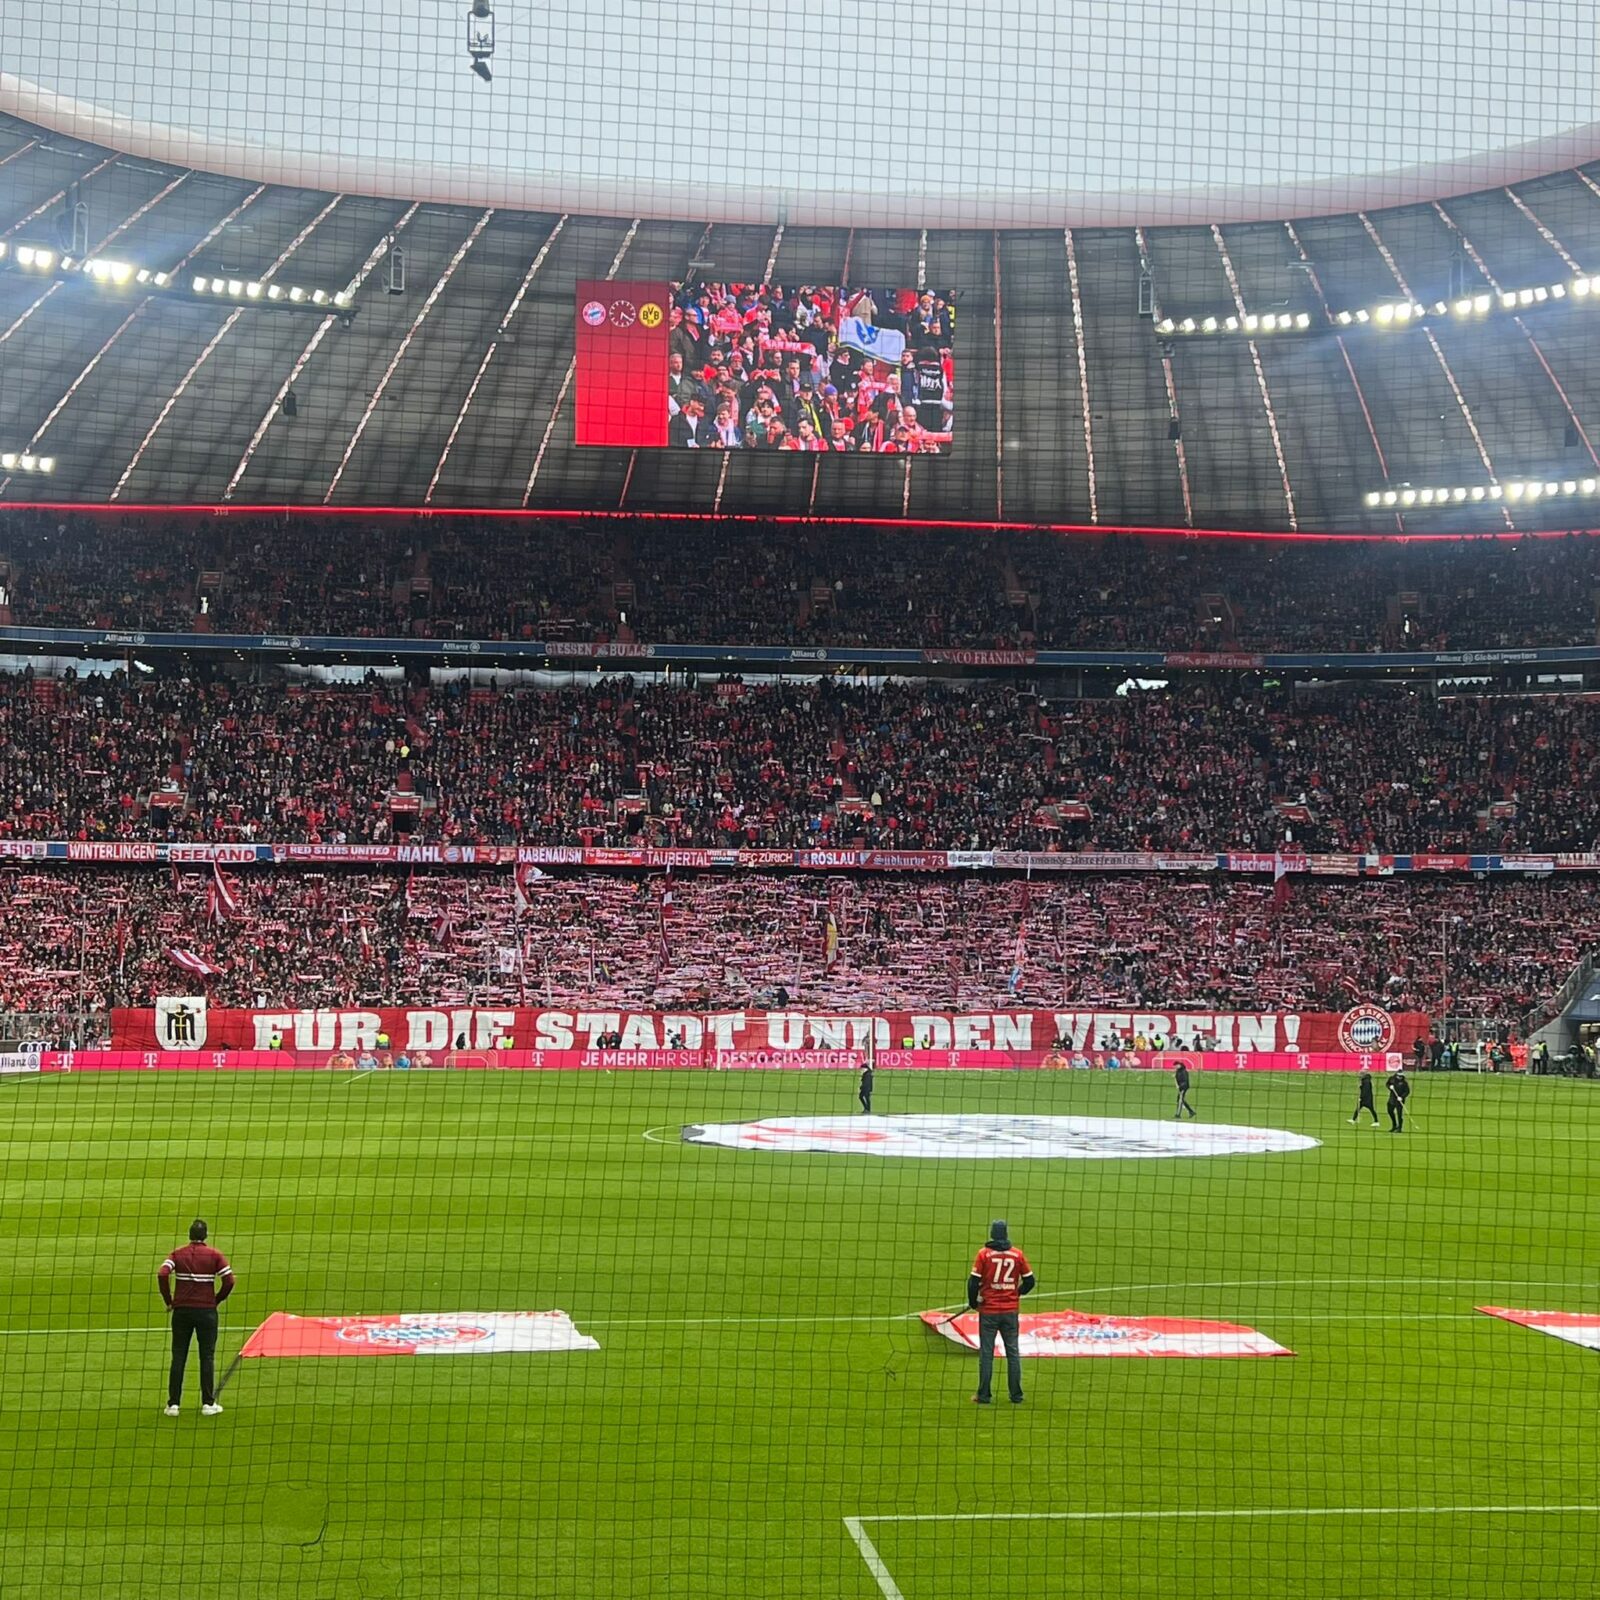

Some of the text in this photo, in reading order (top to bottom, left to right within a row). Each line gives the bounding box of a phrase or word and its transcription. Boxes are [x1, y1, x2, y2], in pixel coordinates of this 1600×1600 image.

[642, 305, 660, 320] BVB
[104, 634, 133, 643] Allianz
[261, 638, 289, 646] Allianz
[442, 642, 469, 651] Allianz
[545, 642, 648, 657] GIESSEN BULLS
[790, 649, 816, 658] Allianz
[973, 650, 1025, 665] FRANKEN
[1474, 653, 1499, 662] Global
[69, 843, 156, 860] WINTERLINGEN
[170, 848, 256, 862] SEELAND
[290, 845, 390, 856] RED STARS UNITED
[738, 851, 758, 863] BFC
[759, 850, 793, 864] ZÜRICH
[810, 850, 855, 865] RÖSLAU
[647, 851, 711, 867] TAUBERTAL
[1230, 855, 1273, 872] Brechen
[252, 1008, 1301, 1053] FÜR DIE STADT UND DEN VEREIN!
[0, 1056, 26, 1068] llianz
[580, 1052, 599, 1067] JE
[602, 1052, 648, 1066] MEHR
[650, 1052, 677, 1066] IHR
[991, 1257, 1015, 1283] 72
